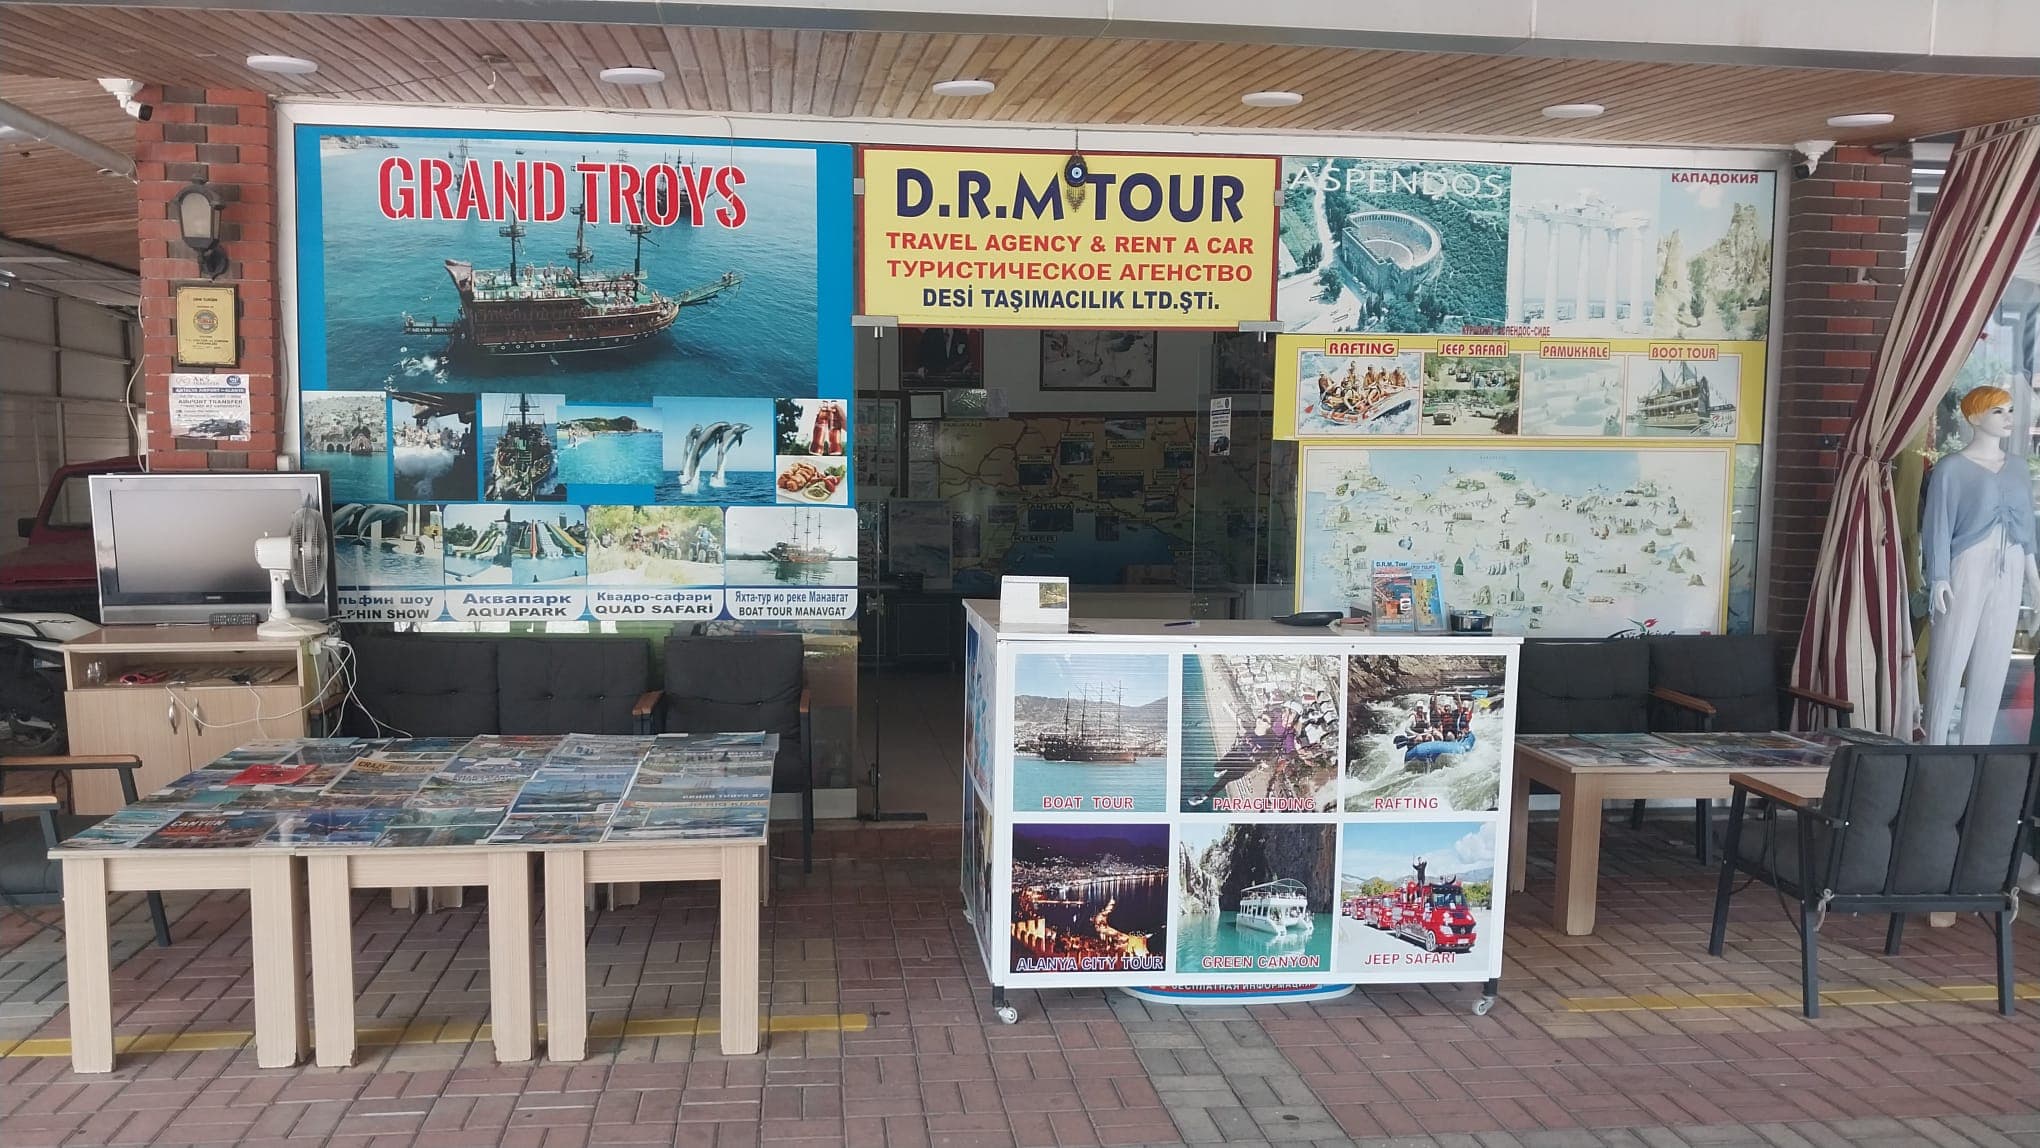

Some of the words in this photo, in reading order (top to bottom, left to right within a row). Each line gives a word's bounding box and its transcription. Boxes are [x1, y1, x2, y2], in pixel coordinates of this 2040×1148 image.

[1289, 166, 1504, 199] ASPENDOS
[1671, 172, 1759, 185] КАПАДОКИЯ
[377, 155, 567, 223] GRAND
[574, 161, 748, 230] TROYS
[896, 168, 1064, 221] D.R.M
[1086, 172, 1245, 224] TOUR
[886, 232, 977, 251] TRAVEL
[985, 233, 1082, 253] AGENCY
[1090, 235, 1106, 253] &
[1115, 236, 1177, 254] RENT
[1184, 237, 1200, 254] A
[1207, 237, 1254, 255] CAR
[886, 260, 1112, 281] ТУРИСТИЧЕСКОЕ
[1119, 263, 1253, 282] АГЕНСТВО
[922, 284, 974, 308] DESİ
[981, 289, 1125, 313] TAŞIMACILIK
[1329, 342, 1395, 355] RAFTING
[1440, 343, 1465, 355] JEEP
[1543, 346, 1608, 358] PAMUKKALE
[1651, 347, 1683, 359] BOOT
[1686, 347, 1716, 360] TOUR
[400, 596, 434, 607] шоу
[462, 592, 572, 606] Аквапарк
[597, 591, 712, 603] Квадро-сафари
[735, 590, 771, 605] Яхта-тур
[787, 593, 807, 605] реке
[809, 591, 849, 603] Манавгат
[387, 609, 430, 619] SHOW
[466, 607, 568, 617] AQUAPARK
[595, 605, 645, 614] QUAD
[739, 606, 764, 616] BOAT
[767, 606, 793, 616] TOUR
[795, 606, 847, 616] MANAVGAT
[1042, 795, 1082, 809] BOAT
[1092, 795, 1134, 809] TOUR
[1213, 796, 1316, 811] PARAGLIDING
[1374, 796, 1439, 810] RAFTING
[1016, 955, 1078, 971] ALANYA
[1080, 955, 1118, 970] CITY
[1120, 954, 1164, 970] TOUR
[1202, 955, 1253, 969] GREEN
[1257, 954, 1320, 968] CANYON
[1364, 953, 1400, 965] JEEP
[1405, 952, 1456, 965] SAFARI
